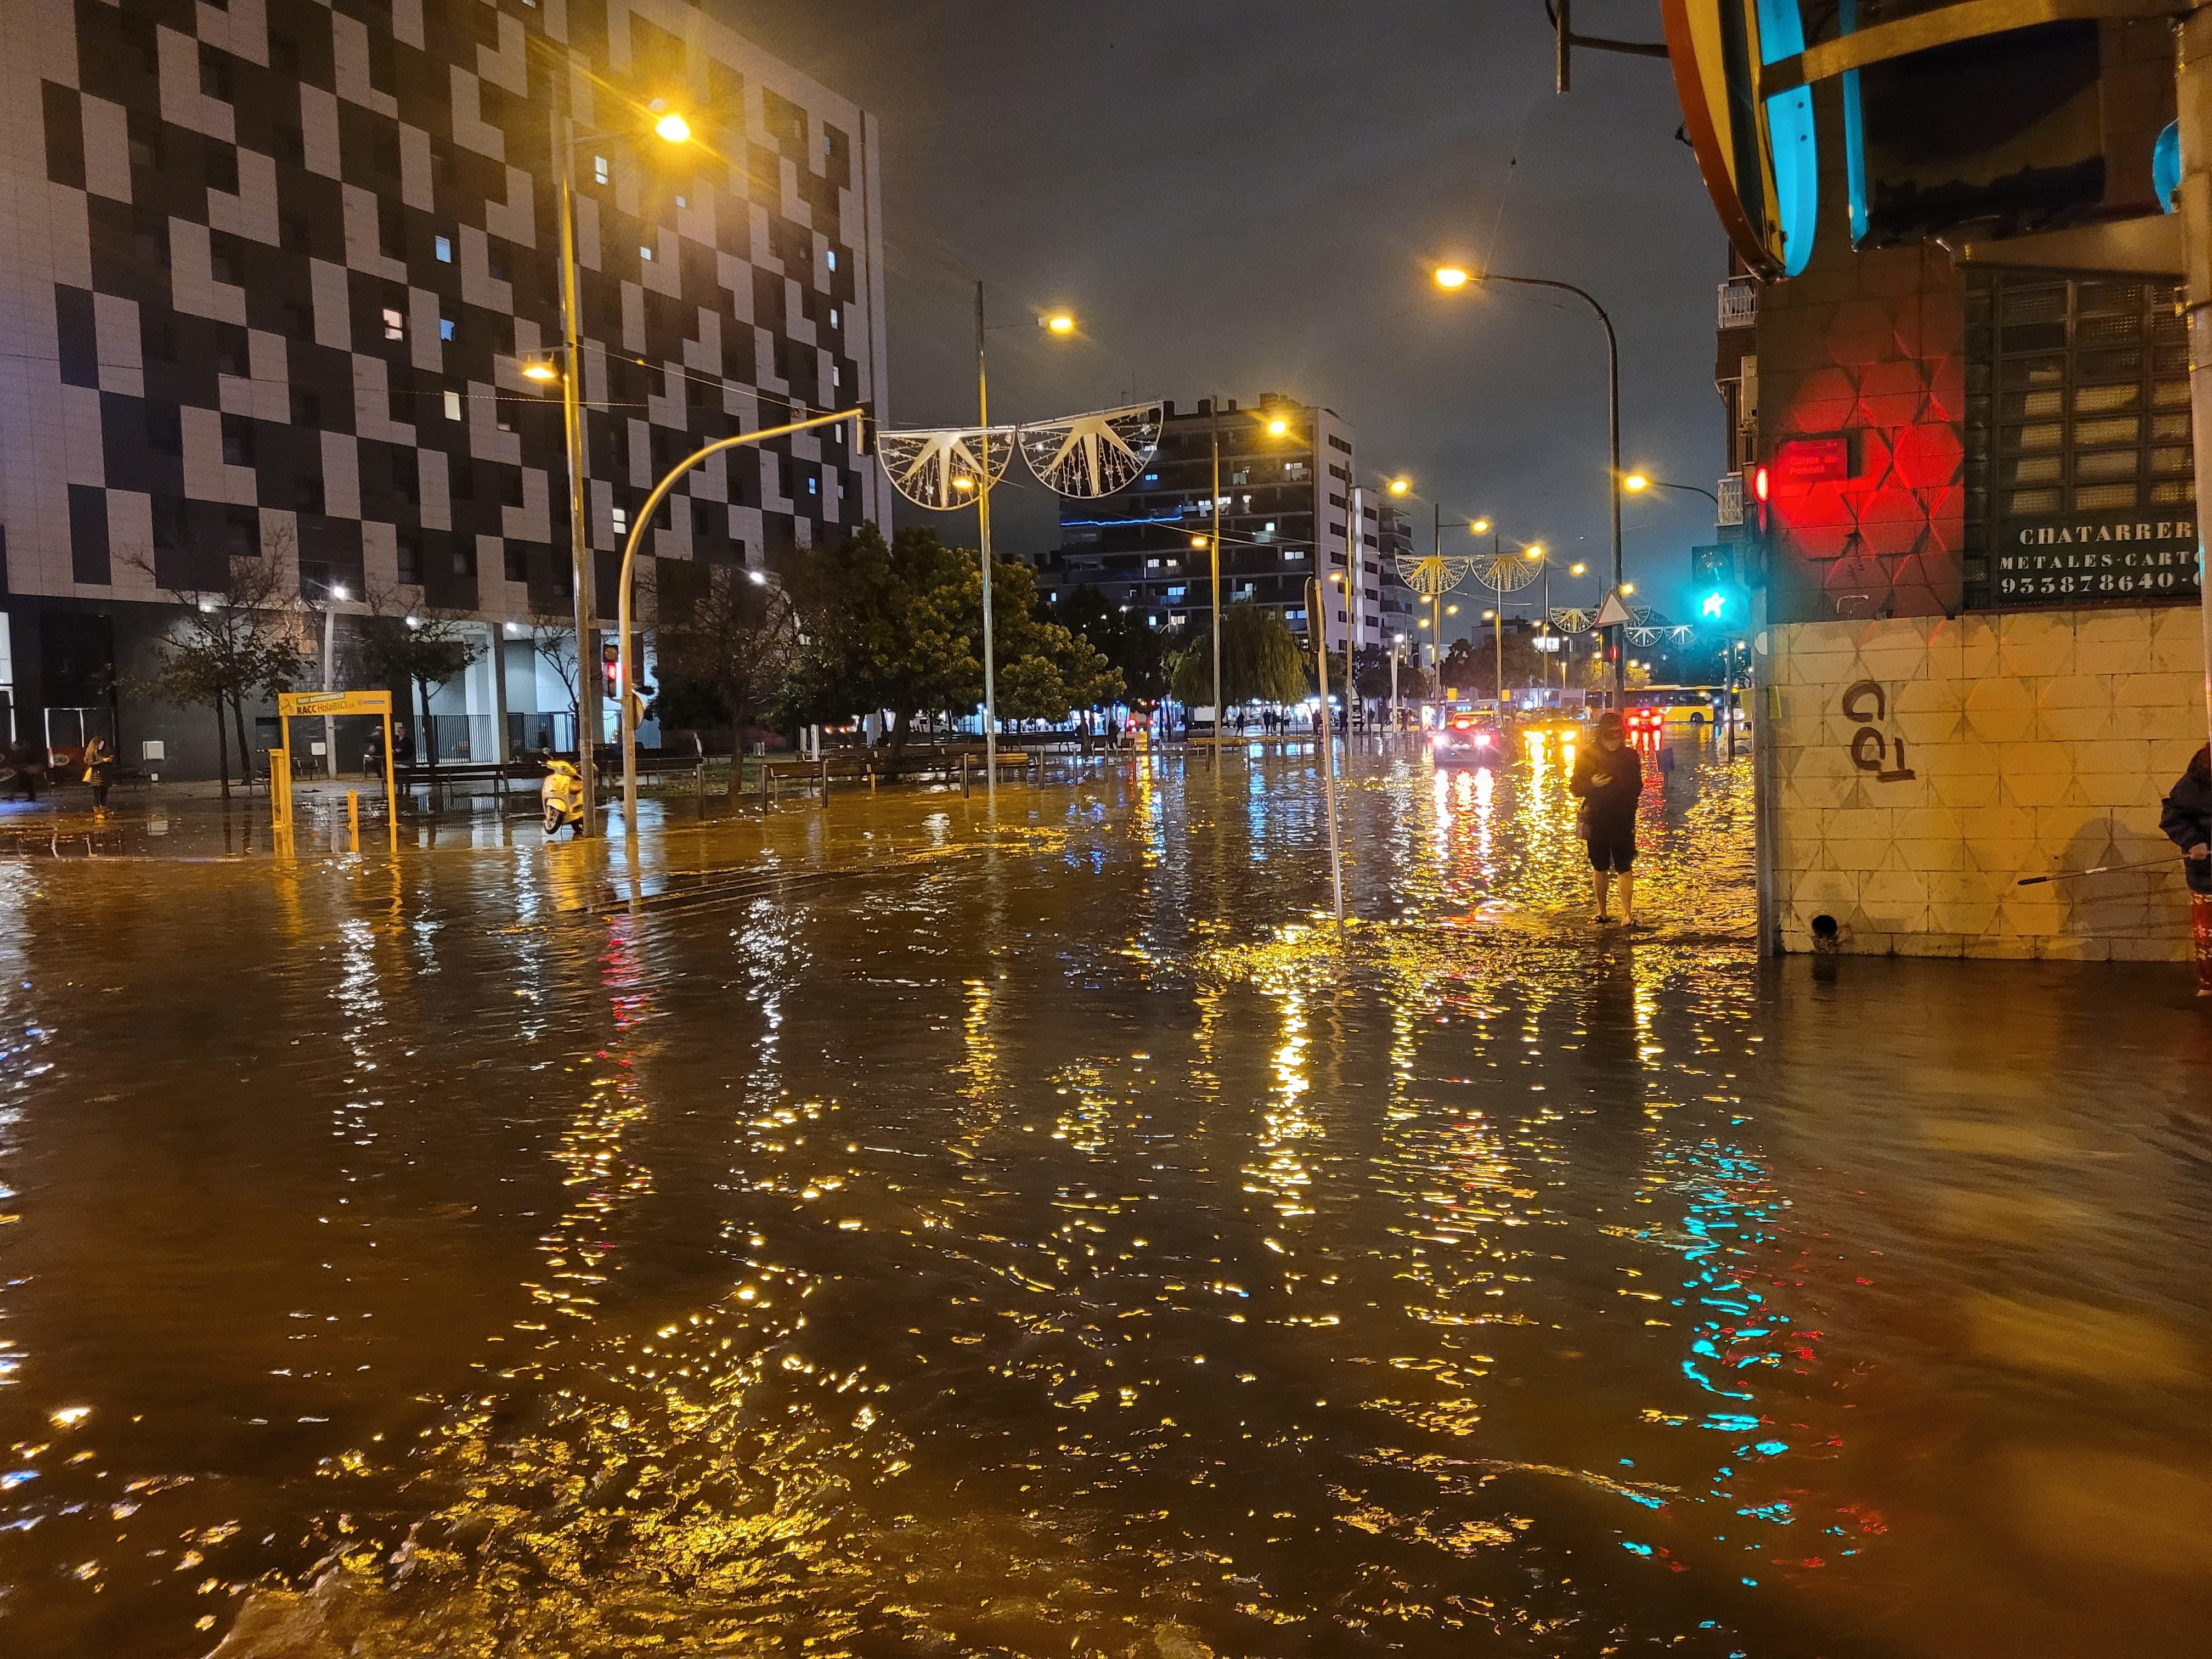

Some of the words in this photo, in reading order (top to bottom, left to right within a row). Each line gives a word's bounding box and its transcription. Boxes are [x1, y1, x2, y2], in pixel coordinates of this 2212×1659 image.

[1789, 465, 1825, 475] Ponent
[2019, 521, 2193, 545] CHATARRER
[297, 704, 317, 715] RACC
